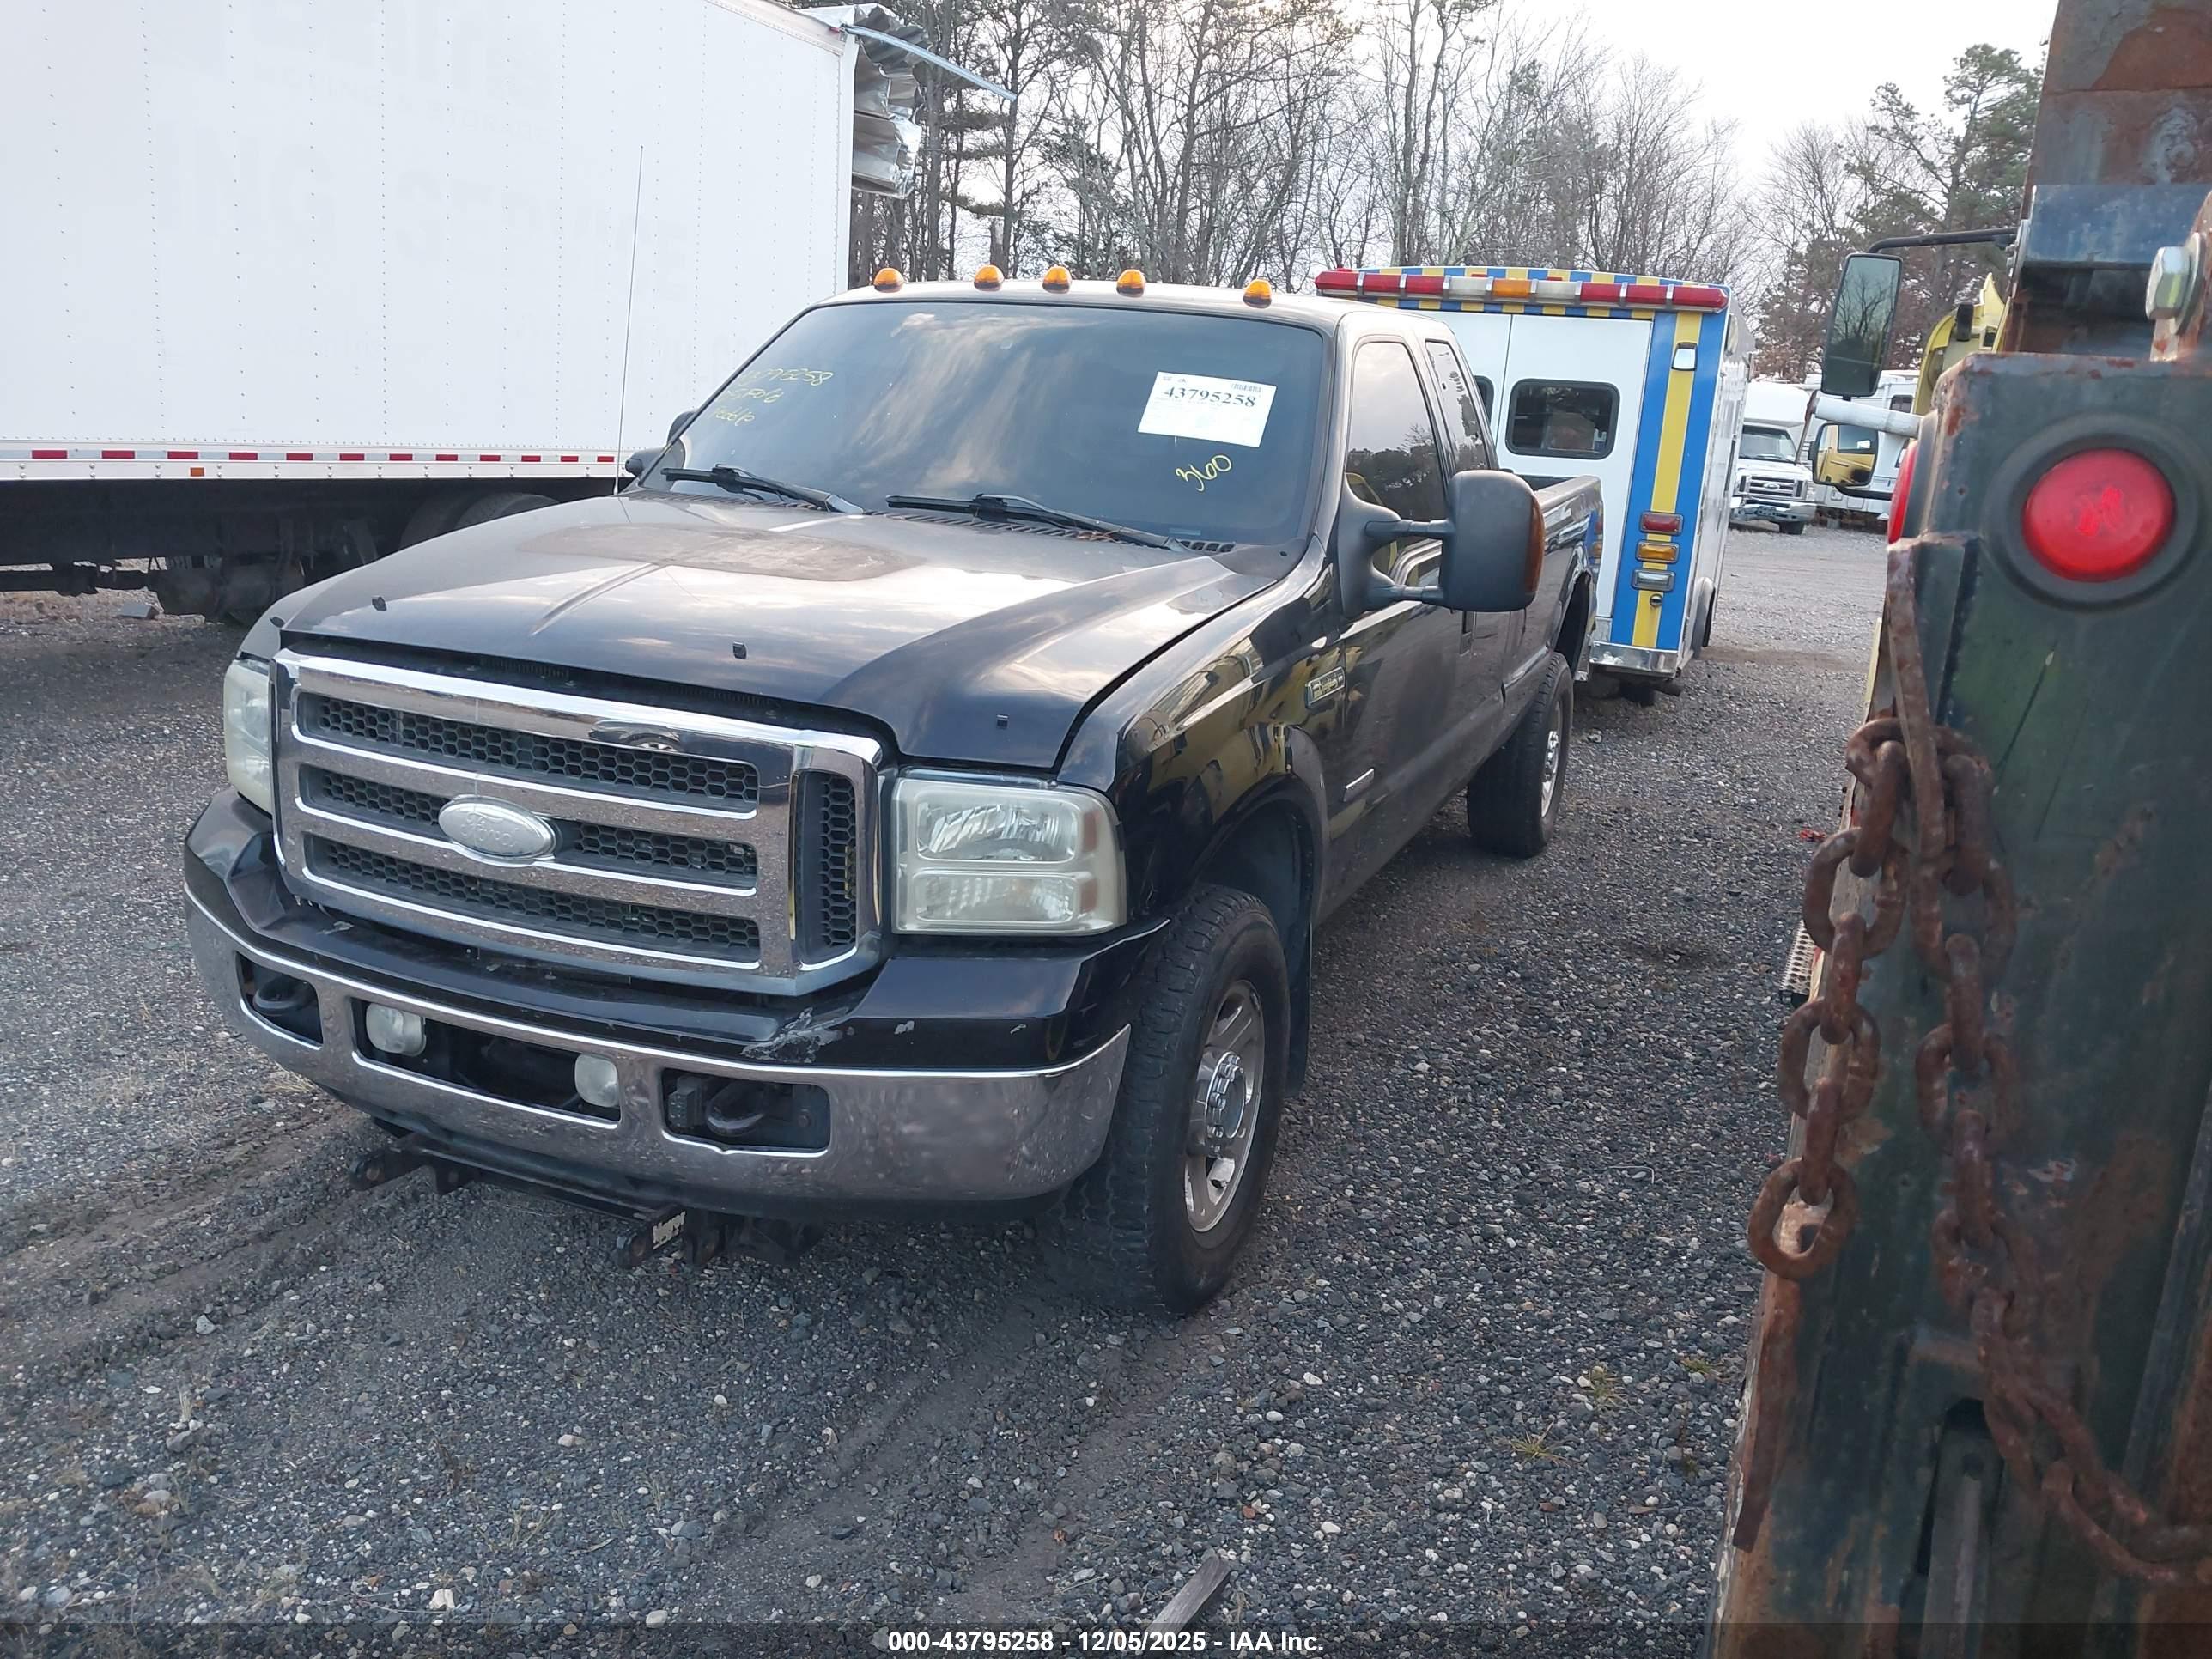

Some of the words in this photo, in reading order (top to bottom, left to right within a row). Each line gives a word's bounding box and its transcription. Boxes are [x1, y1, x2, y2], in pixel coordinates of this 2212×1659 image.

[1163, 386, 1257, 409] 43795258
[1174, 453, 1232, 492] 360
[459, 810, 522, 848] Ford
